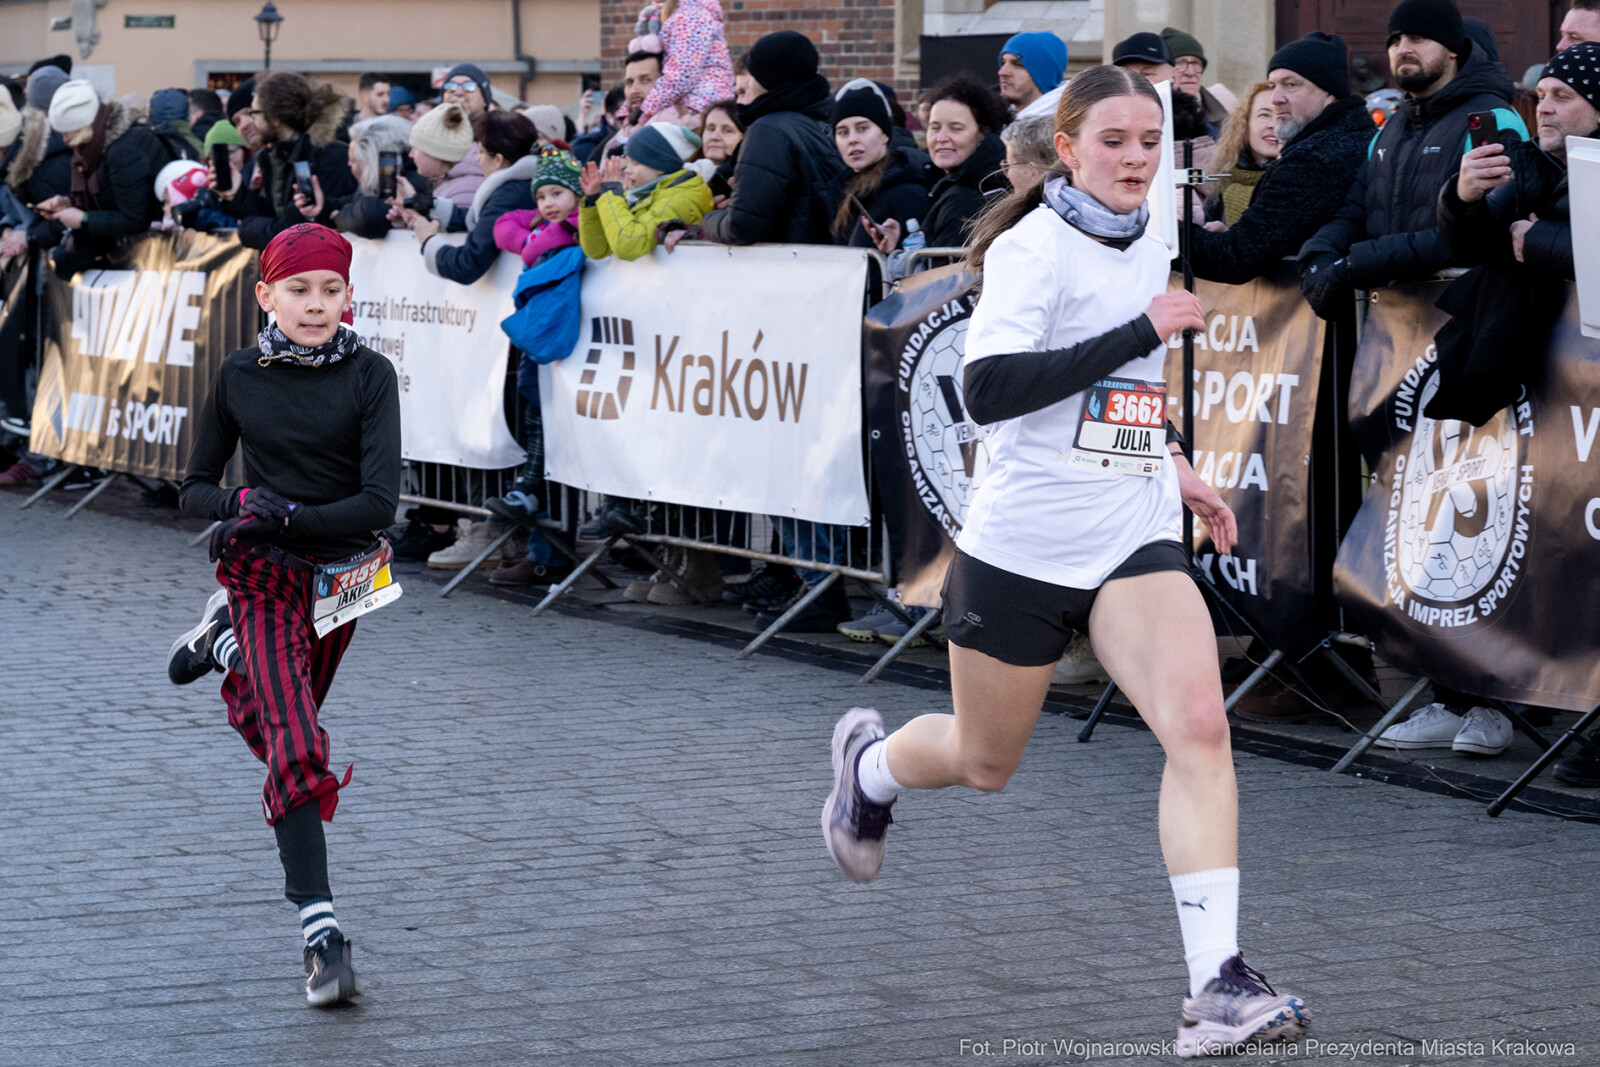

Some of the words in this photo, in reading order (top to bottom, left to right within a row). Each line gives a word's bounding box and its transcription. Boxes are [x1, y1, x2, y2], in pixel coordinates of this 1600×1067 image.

[350, 296, 388, 326] arząd
[390, 296, 477, 333] Infrastruktury
[898, 299, 966, 393] FUNDACJA
[650, 328, 808, 423] Kraków
[1395, 343, 1438, 432] FUNDAC
[106, 398, 121, 437] is
[121, 400, 188, 446] SPORT
[1108, 393, 1162, 425] 3662
[1112, 428, 1151, 452] JULIA
[1384, 454, 1407, 612] ORGANIZACJA
[1407, 599, 1478, 628] IMPREZ
[1478, 464, 1534, 617] SPORTOWYCH
[337, 557, 382, 593] 2159
